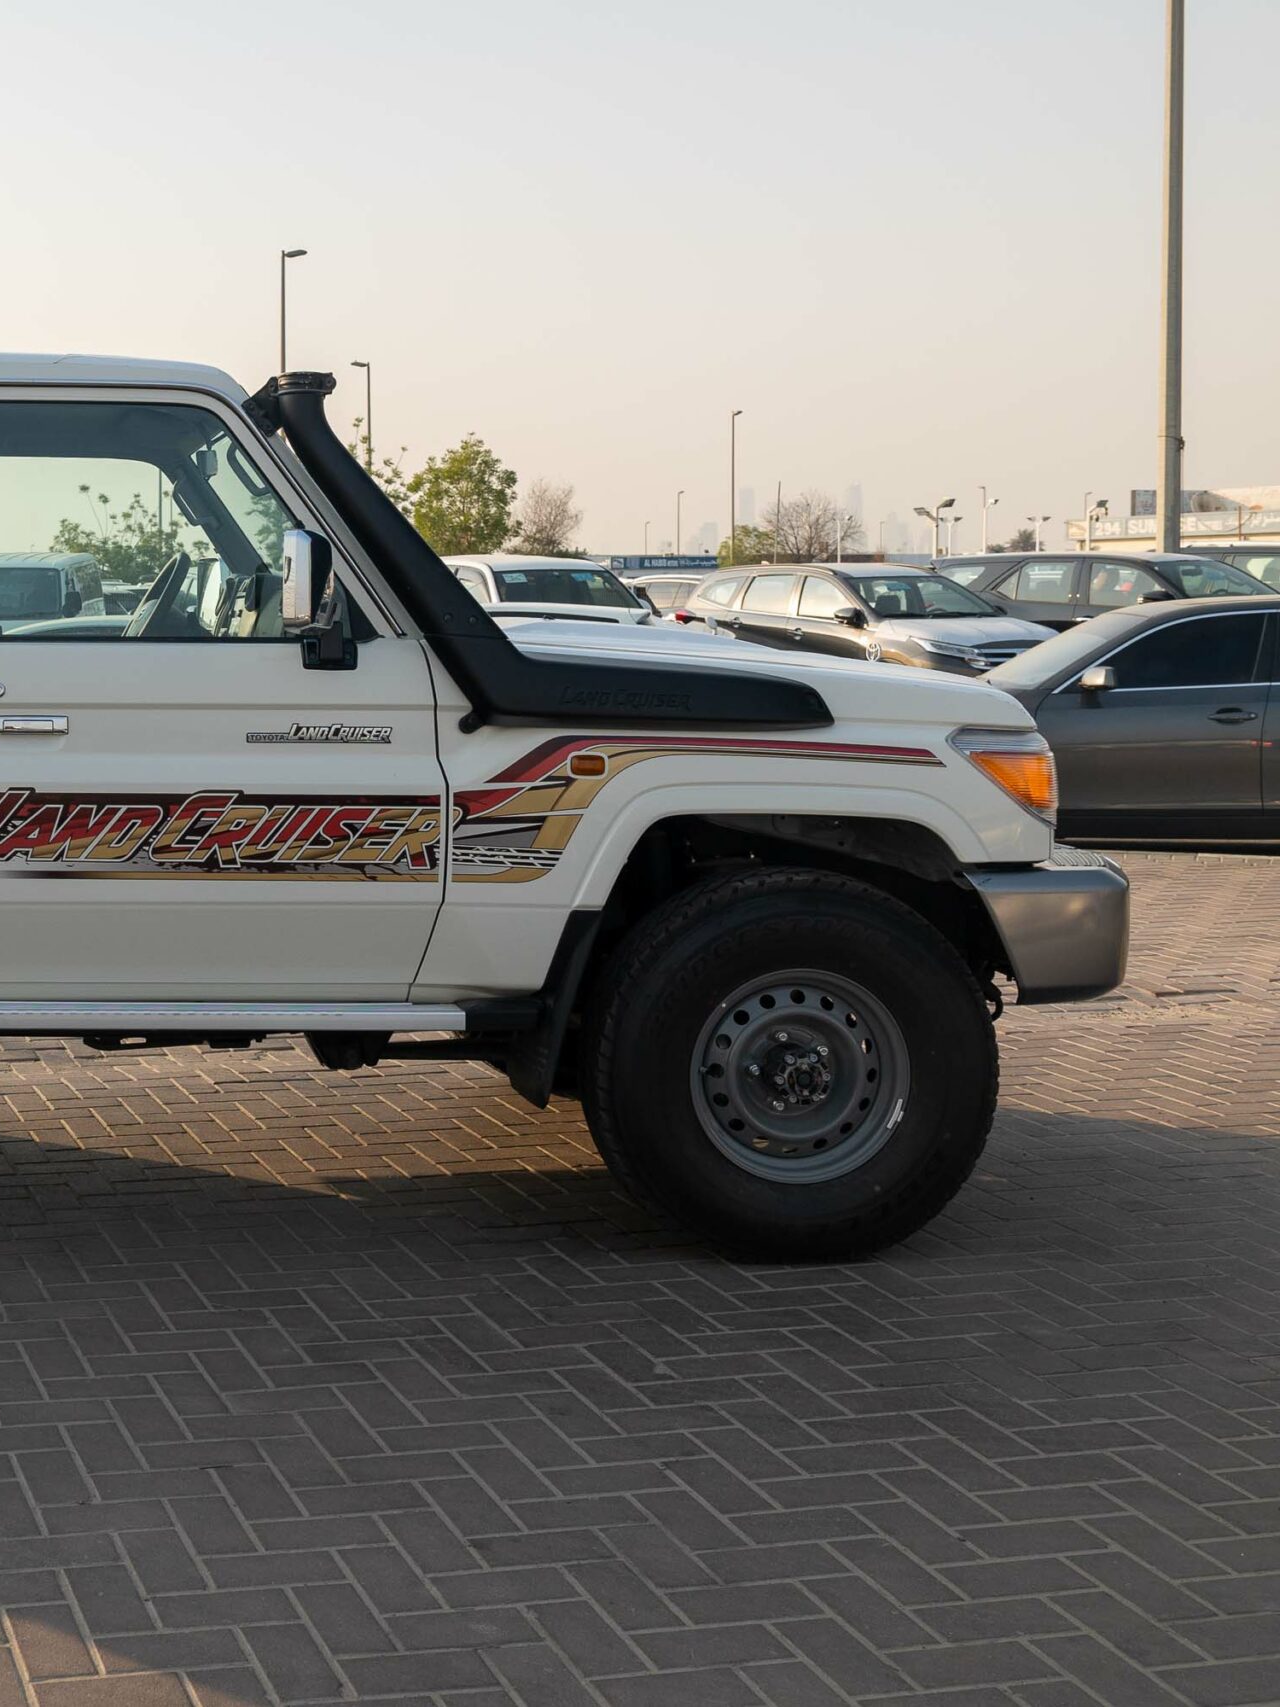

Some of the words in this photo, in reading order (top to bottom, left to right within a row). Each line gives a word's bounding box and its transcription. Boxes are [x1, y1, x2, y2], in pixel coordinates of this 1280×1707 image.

[557, 685, 613, 707] LAND
[249, 734, 286, 742] TOYOTA
[150, 790, 461, 870] CRUISER
